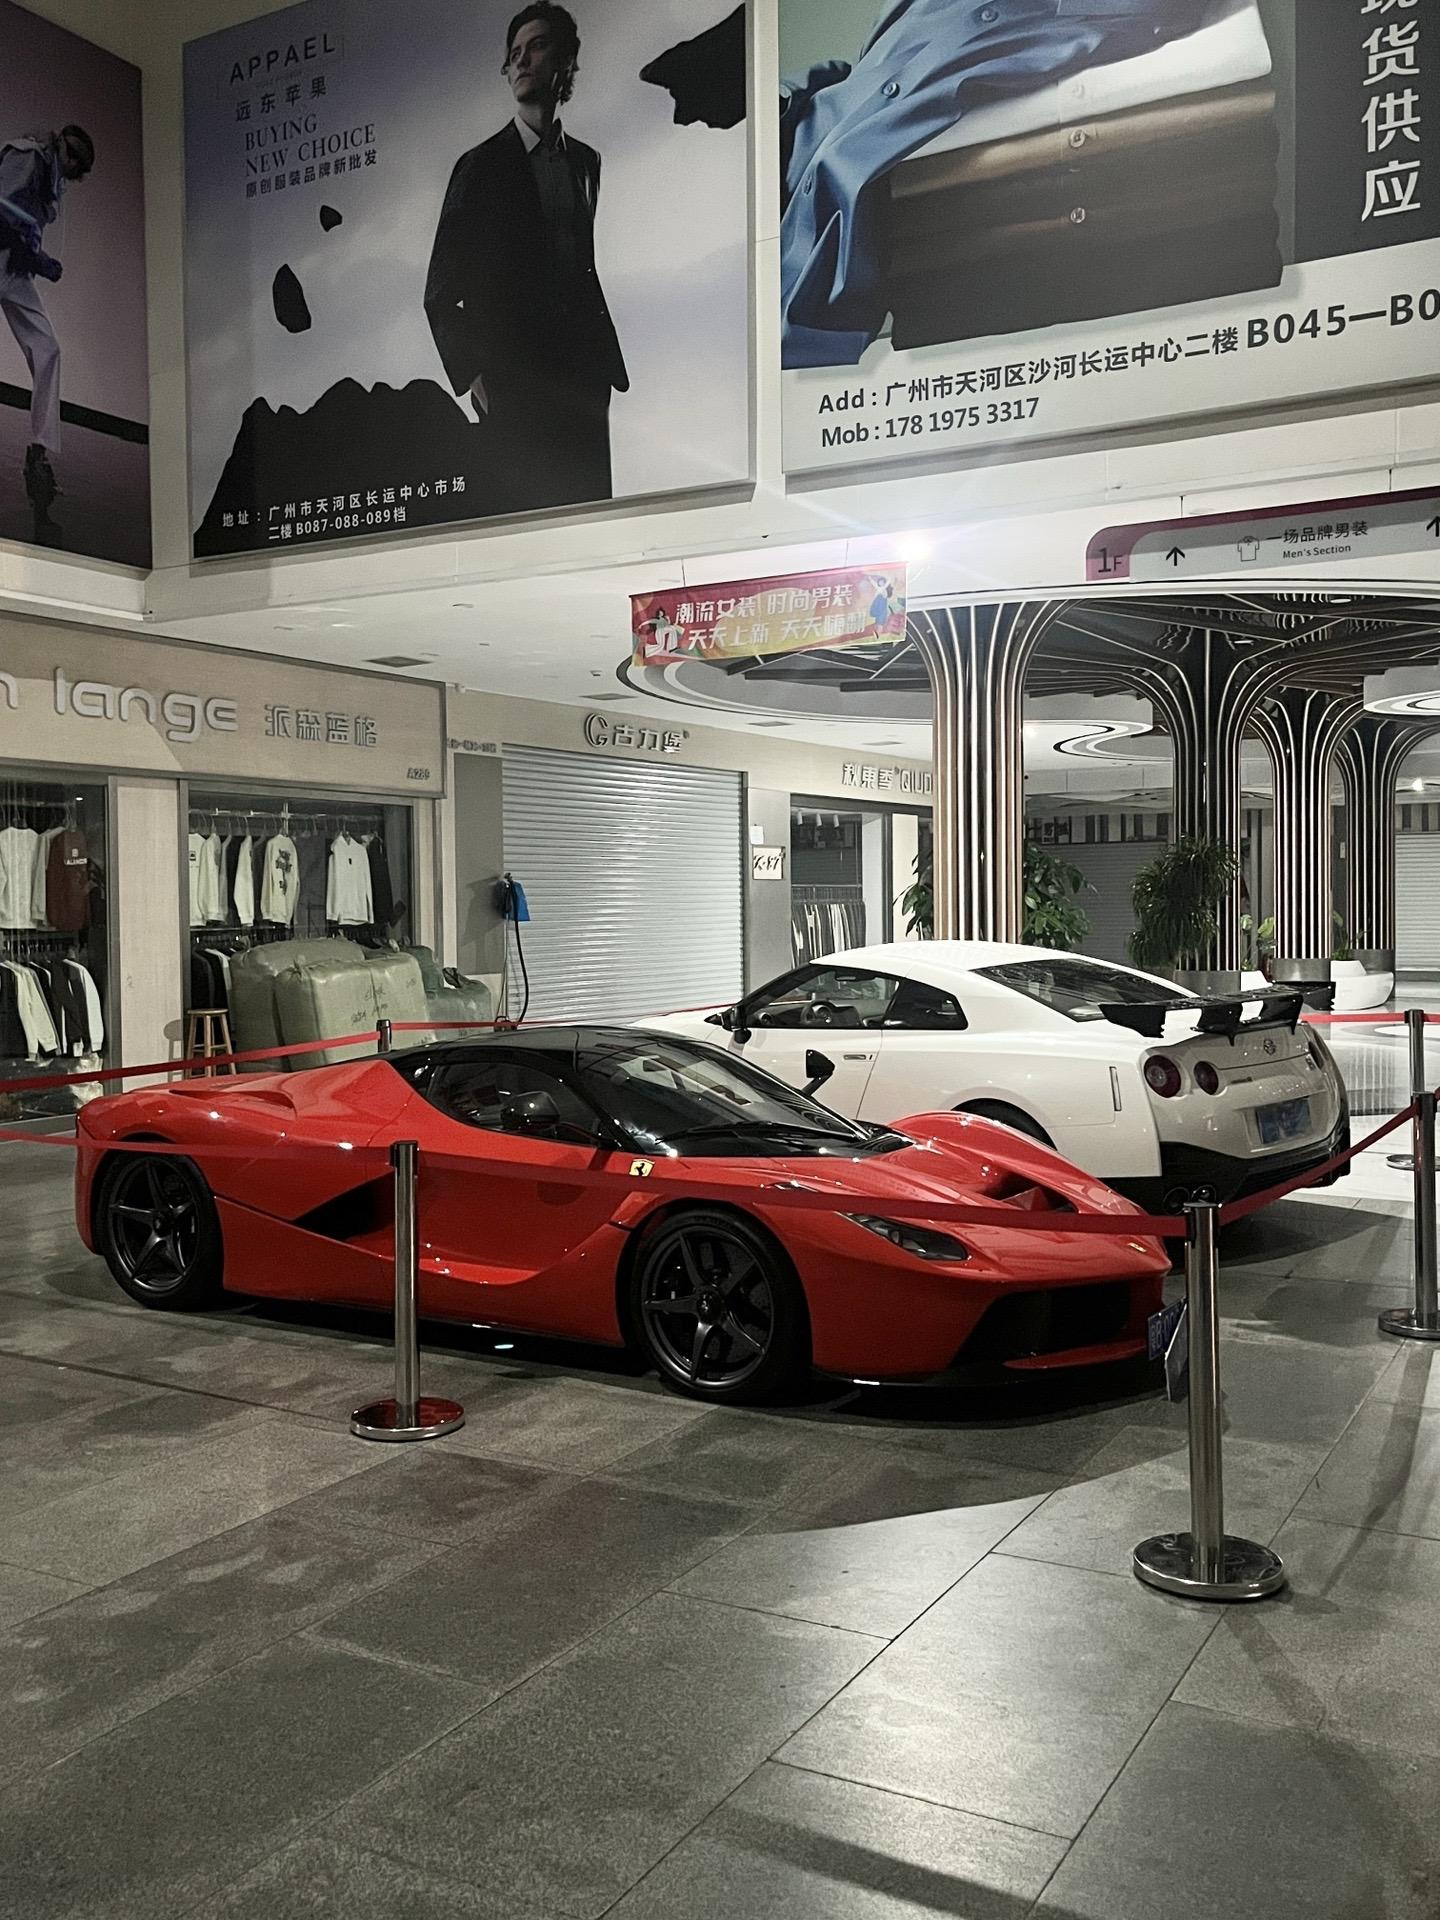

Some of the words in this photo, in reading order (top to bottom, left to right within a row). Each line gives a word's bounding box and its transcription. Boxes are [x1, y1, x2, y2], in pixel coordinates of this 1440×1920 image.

[230, 34, 335, 85] APPAEL
[236, 76, 326, 121] 远东苹果
[1360, 0, 1421, 222] 货供应
[245, 114, 317, 150] BUYING
[246, 148, 288, 177] NEW
[298, 123, 376, 161] CHOICE
[246, 150, 377, 198] 原创服装品牌新批发
[885, 415, 923, 438] 178
[929, 407, 980, 432] 1975
[987, 397, 1040, 424] 3317
[1266, 520, 1368, 544] 一场品牌男装
[1283, 549, 1311, 559] Men's
[1313, 544, 1351, 555] Section
[675, 596, 756, 625] 潮流女装
[767, 584, 855, 615] 时尚男装
[688, 622, 769, 650] 天天上新
[53, 666, 239, 744] lange
